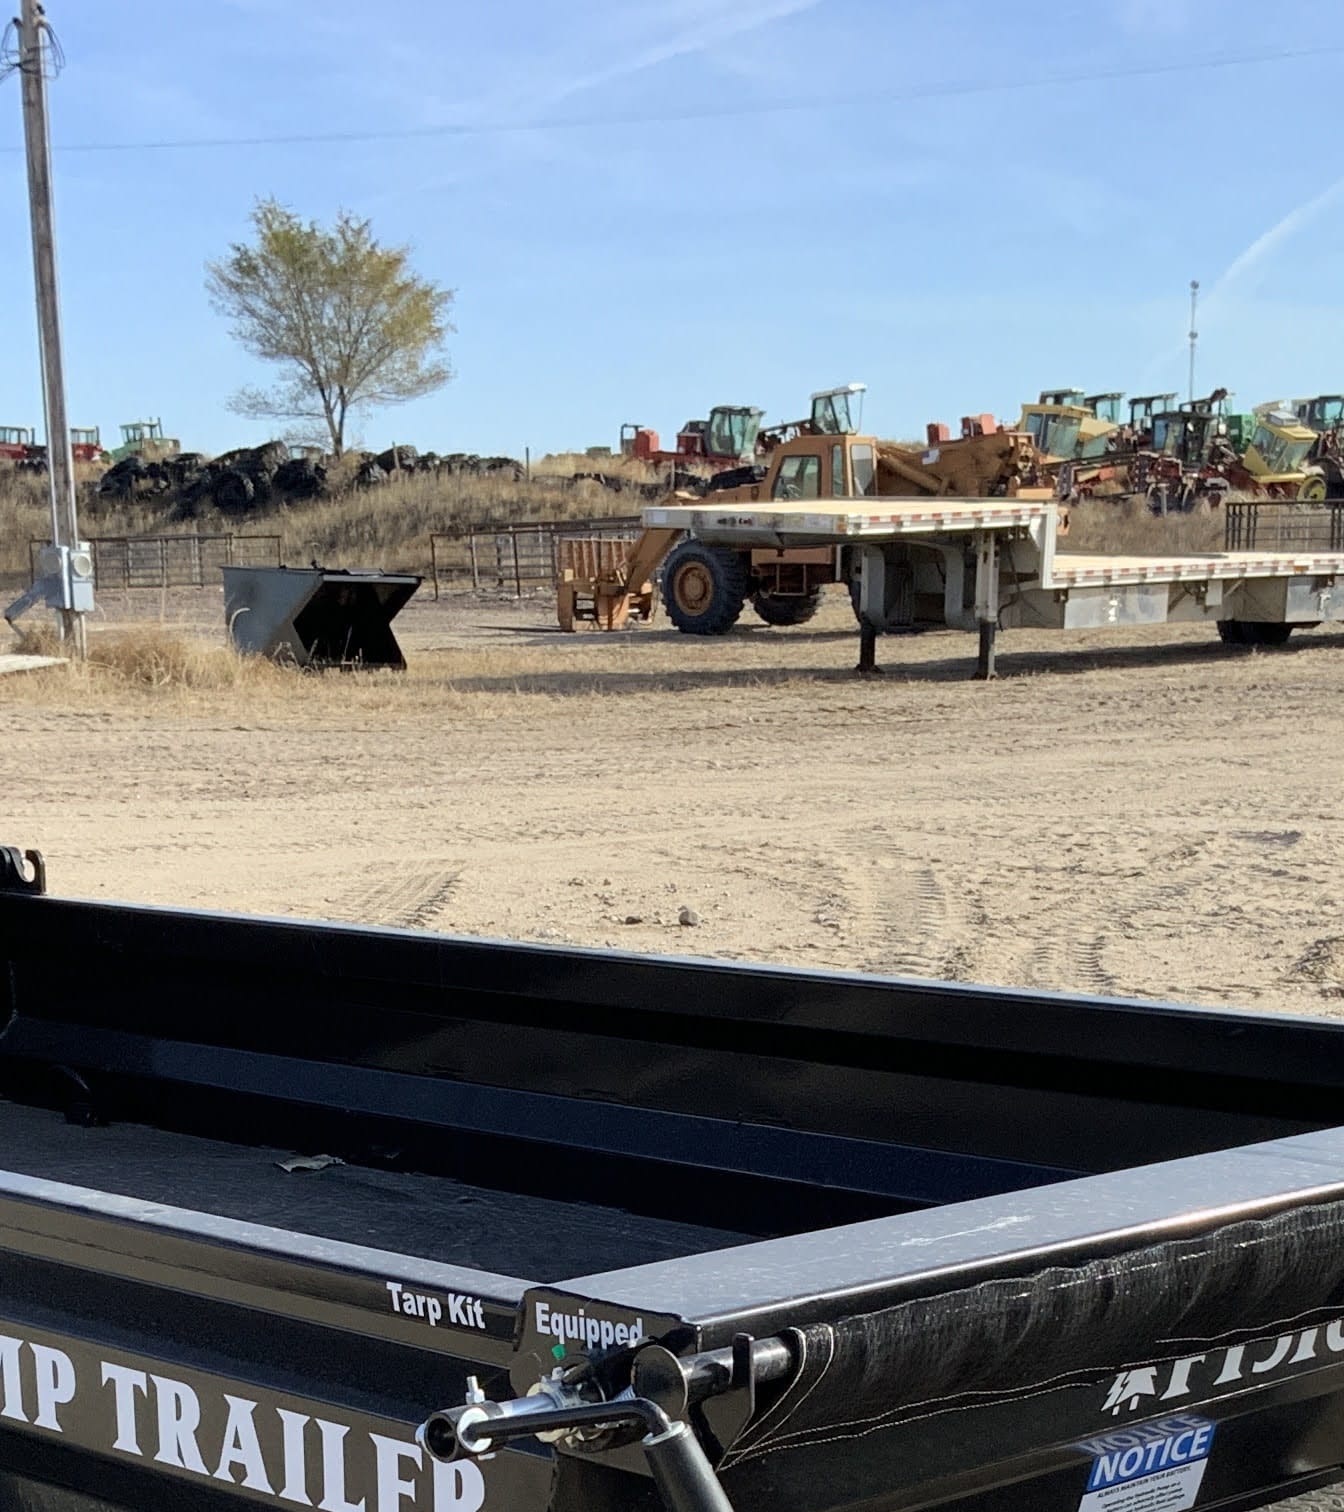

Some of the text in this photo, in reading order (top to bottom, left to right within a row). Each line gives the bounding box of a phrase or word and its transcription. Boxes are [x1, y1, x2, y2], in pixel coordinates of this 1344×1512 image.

[385, 1280, 644, 1350] Tarp Kit Equipped
[1092, 1425, 1212, 1487] NOTICE
